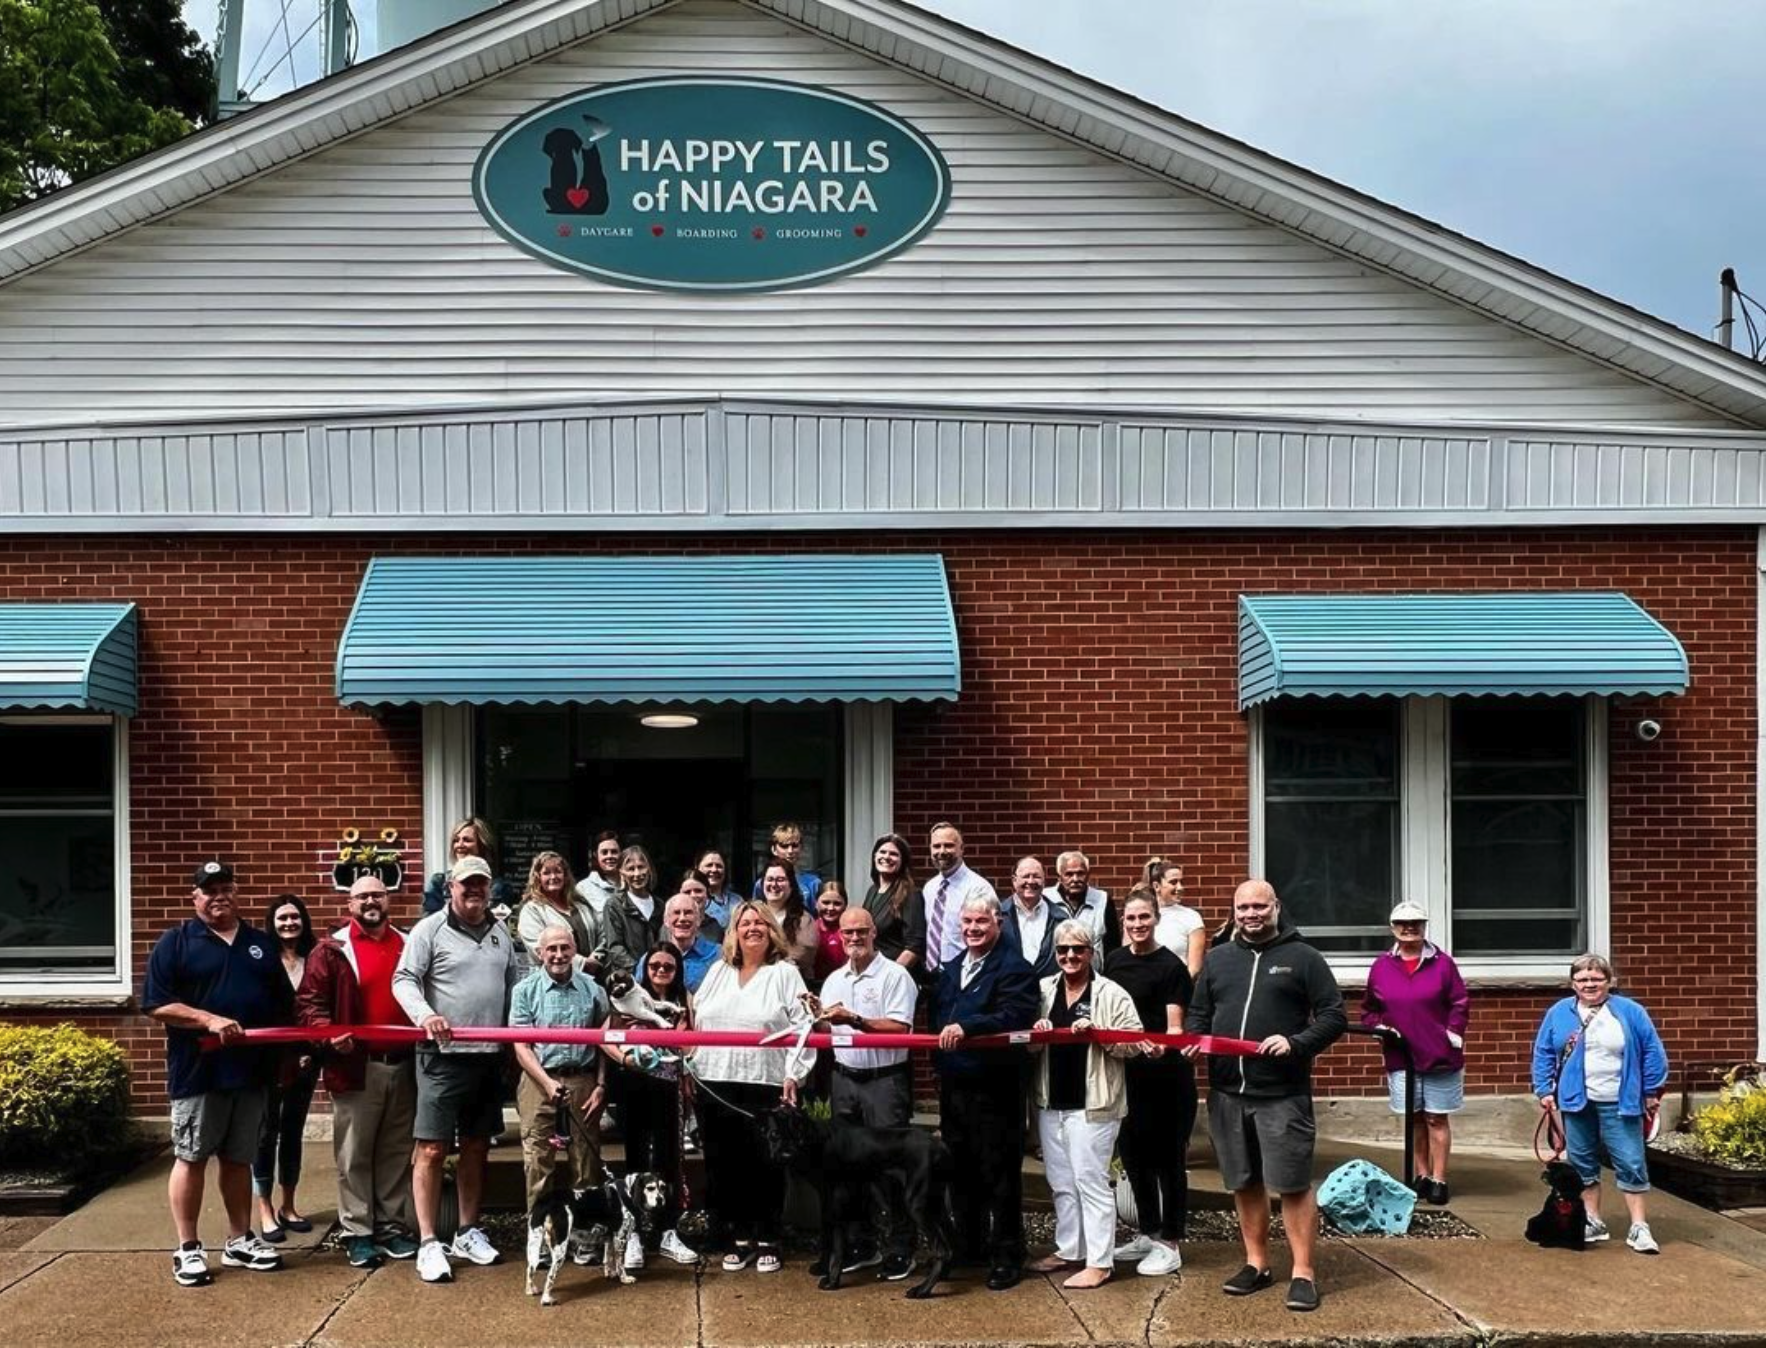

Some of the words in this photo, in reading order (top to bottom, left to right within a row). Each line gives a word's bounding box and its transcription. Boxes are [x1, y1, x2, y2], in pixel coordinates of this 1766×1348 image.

[620, 139, 764, 173] HAPPY
[774, 141, 890, 173] TAILS
[632, 179, 669, 212] of
[681, 180, 878, 213] NIAGARA
[581, 227, 633, 237] DAYCARE
[677, 229, 737, 238] BOARDING
[776, 229, 842, 238] GROOMING
